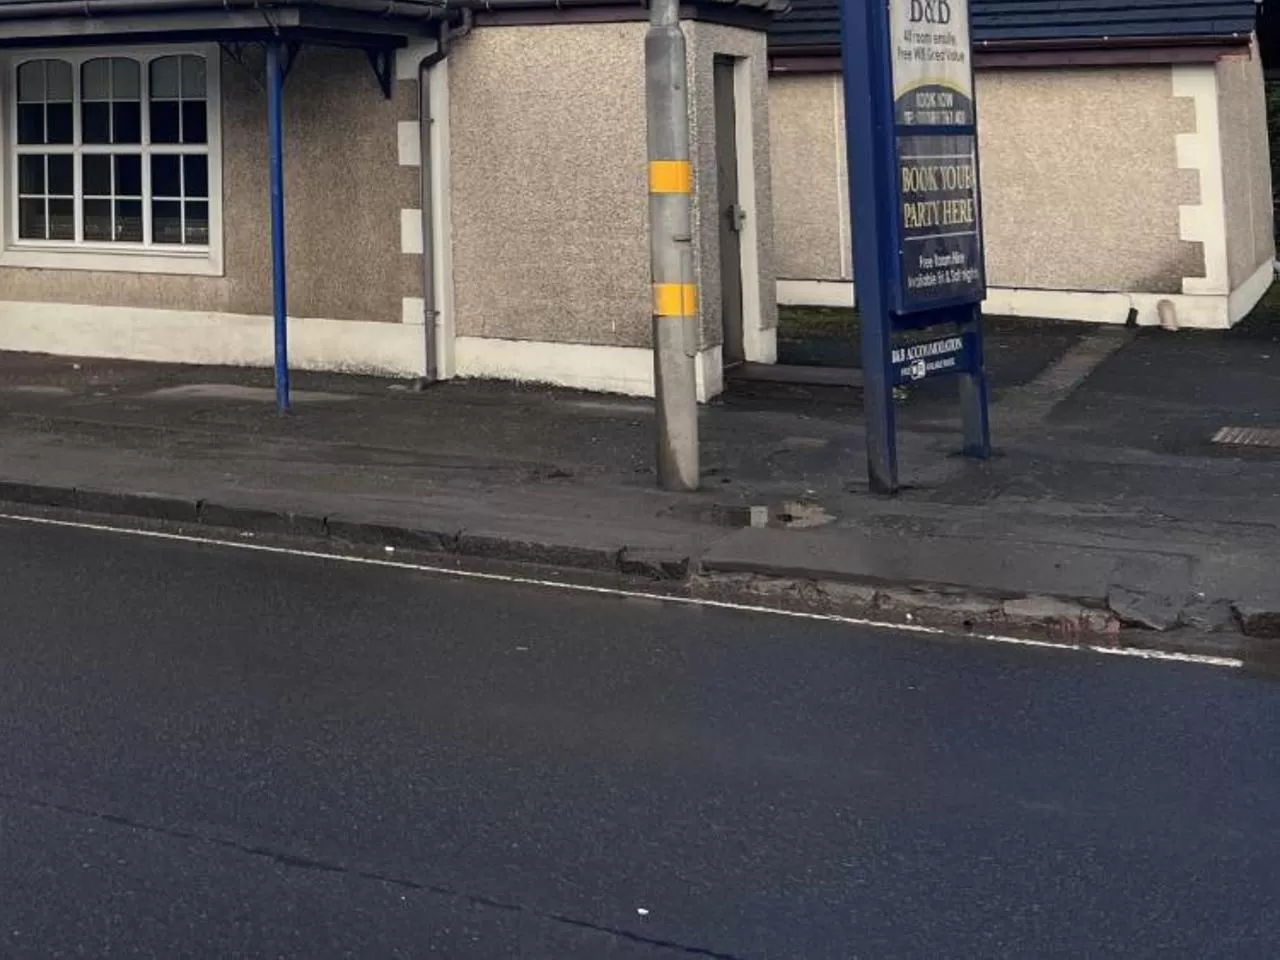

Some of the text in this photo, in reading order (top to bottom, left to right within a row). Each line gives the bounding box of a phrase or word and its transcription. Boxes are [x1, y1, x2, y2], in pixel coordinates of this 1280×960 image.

[902, 165, 973, 193] BOOK YOUR
[904, 198, 974, 228] PARTY HERE
